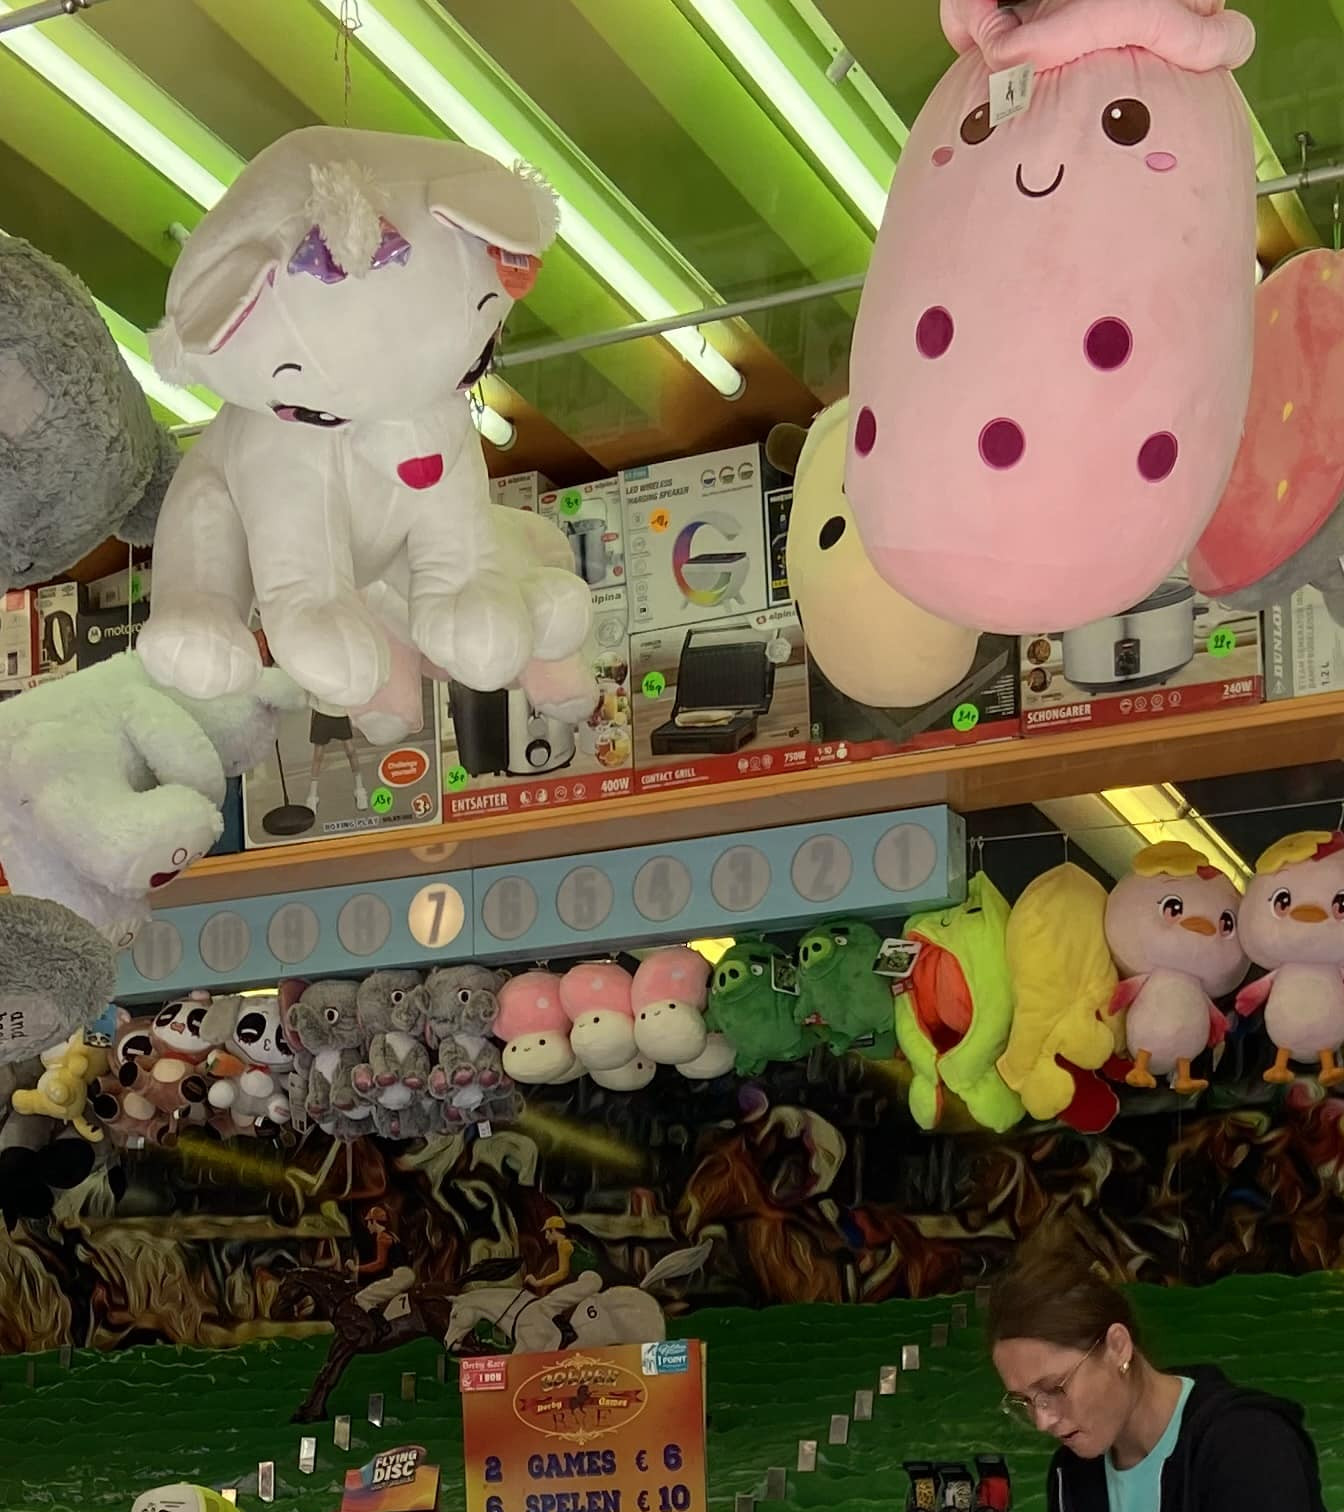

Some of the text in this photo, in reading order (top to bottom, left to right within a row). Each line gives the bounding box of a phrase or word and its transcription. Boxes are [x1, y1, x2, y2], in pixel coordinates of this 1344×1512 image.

[1223, 680, 1252, 697] 240W
[1027, 704, 1091, 724] SCHONGARER
[601, 777, 630, 793] 400W
[641, 767, 697, 786] CONTACT GRILL
[452, 793, 508, 813] ENTSAFTER
[427, 890, 446, 946] 7
[573, 871, 598, 926] 5
[647, 861, 676, 916] 4
[727, 851, 754, 906] 3
[809, 841, 836, 898] 2
[892, 828, 913, 887] 1
[9, 1011, 24, 1039] and
[398, 1297, 407, 1309] 7
[586, 1305, 598, 1319] 6
[663, 1354, 687, 1364] POINT
[537, 1396, 629, 1413] Derby Games
[376, 1450, 418, 1467] FLYING
[485, 1443, 683, 1483] 2 GAMES € 6
[373, 1464, 416, 1484] DISC
[637, 1490, 650, 1512] €
[658, 1484, 691, 1512] 10
